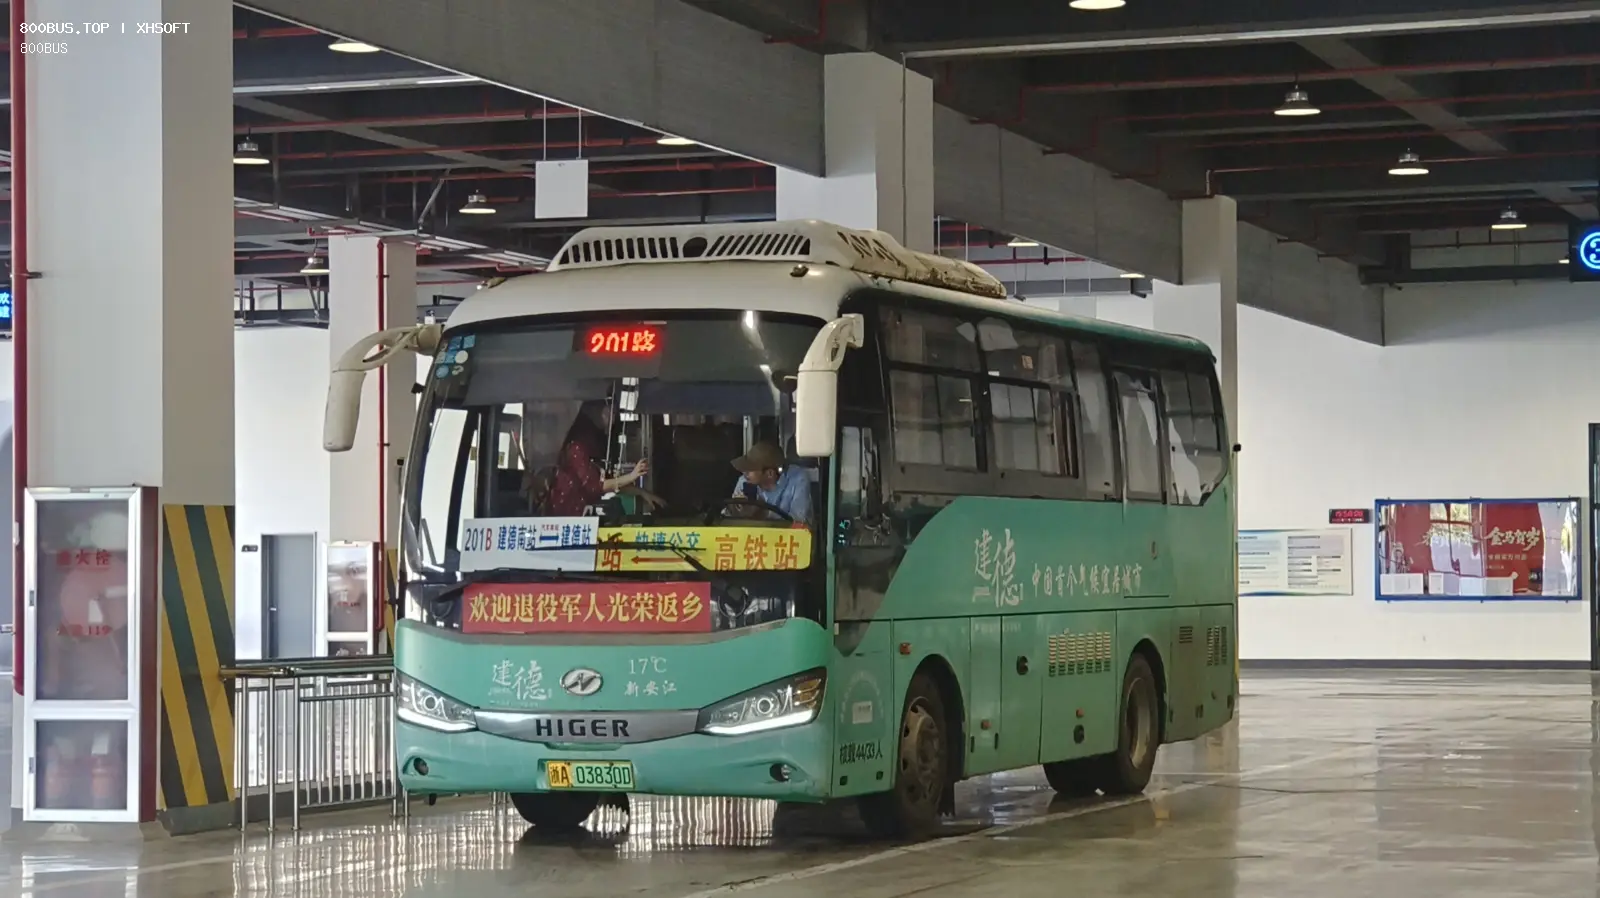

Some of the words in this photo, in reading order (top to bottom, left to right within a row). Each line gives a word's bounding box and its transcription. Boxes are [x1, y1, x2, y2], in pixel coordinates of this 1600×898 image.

[590, 329, 656, 352] 201路
[464, 527, 493, 551] 201B
[497, 524, 537, 551] 建德南站
[561, 523, 592, 547] 建德站
[714, 534, 800, 571] 高铁站
[468, 592, 704, 623] 欢迎退役军人光荣返乡
[624, 680, 677, 697] 新安江
[535, 718, 630, 737] HIGER
